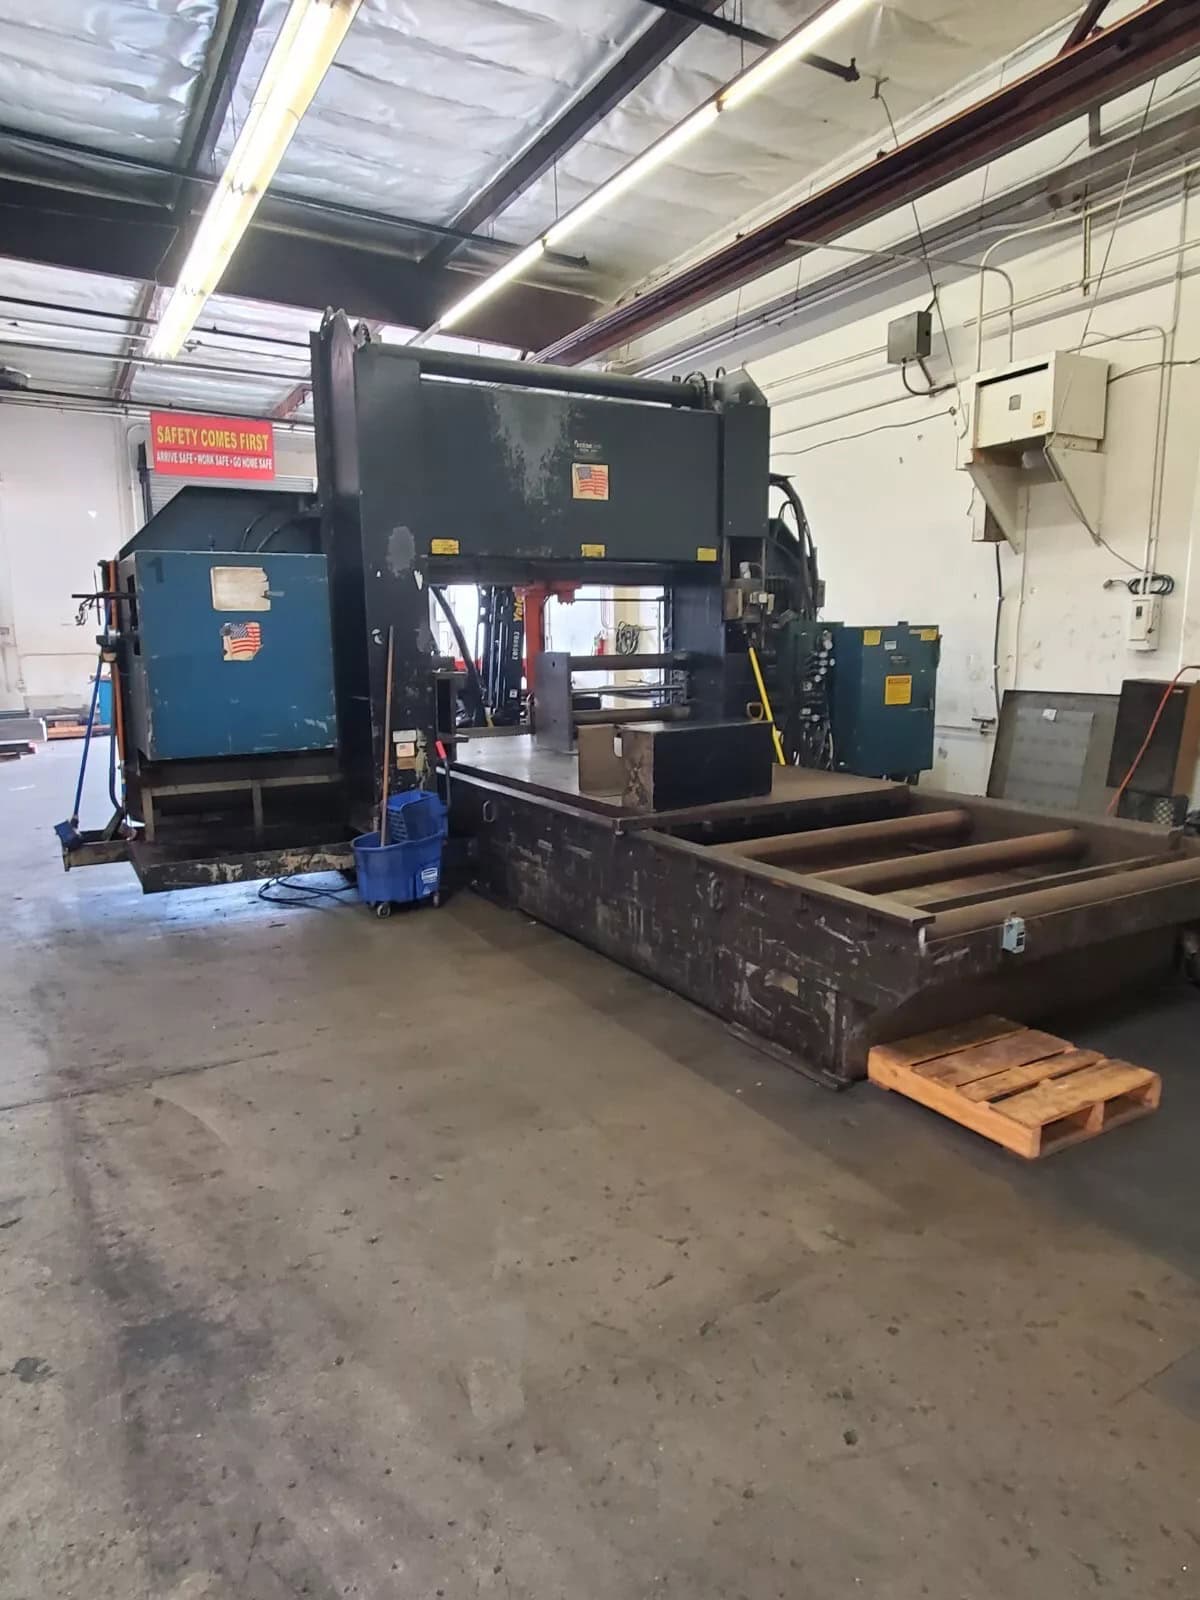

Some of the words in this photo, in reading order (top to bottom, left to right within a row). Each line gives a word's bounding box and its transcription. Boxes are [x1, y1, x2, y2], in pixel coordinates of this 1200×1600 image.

[157, 425, 198, 446] SAFETY
[200, 429, 238, 449] COMES
[240, 433, 269, 452] FIRST
[157, 451, 178, 463] ARRIVE
[179, 452, 193, 465] SAFE
[197, 453, 215, 465] WORK
[215, 455, 229, 467] SAFE
[232, 456, 241, 468] GO
[241, 457, 258, 469] HOME
[258, 458, 273, 470] SAFE
